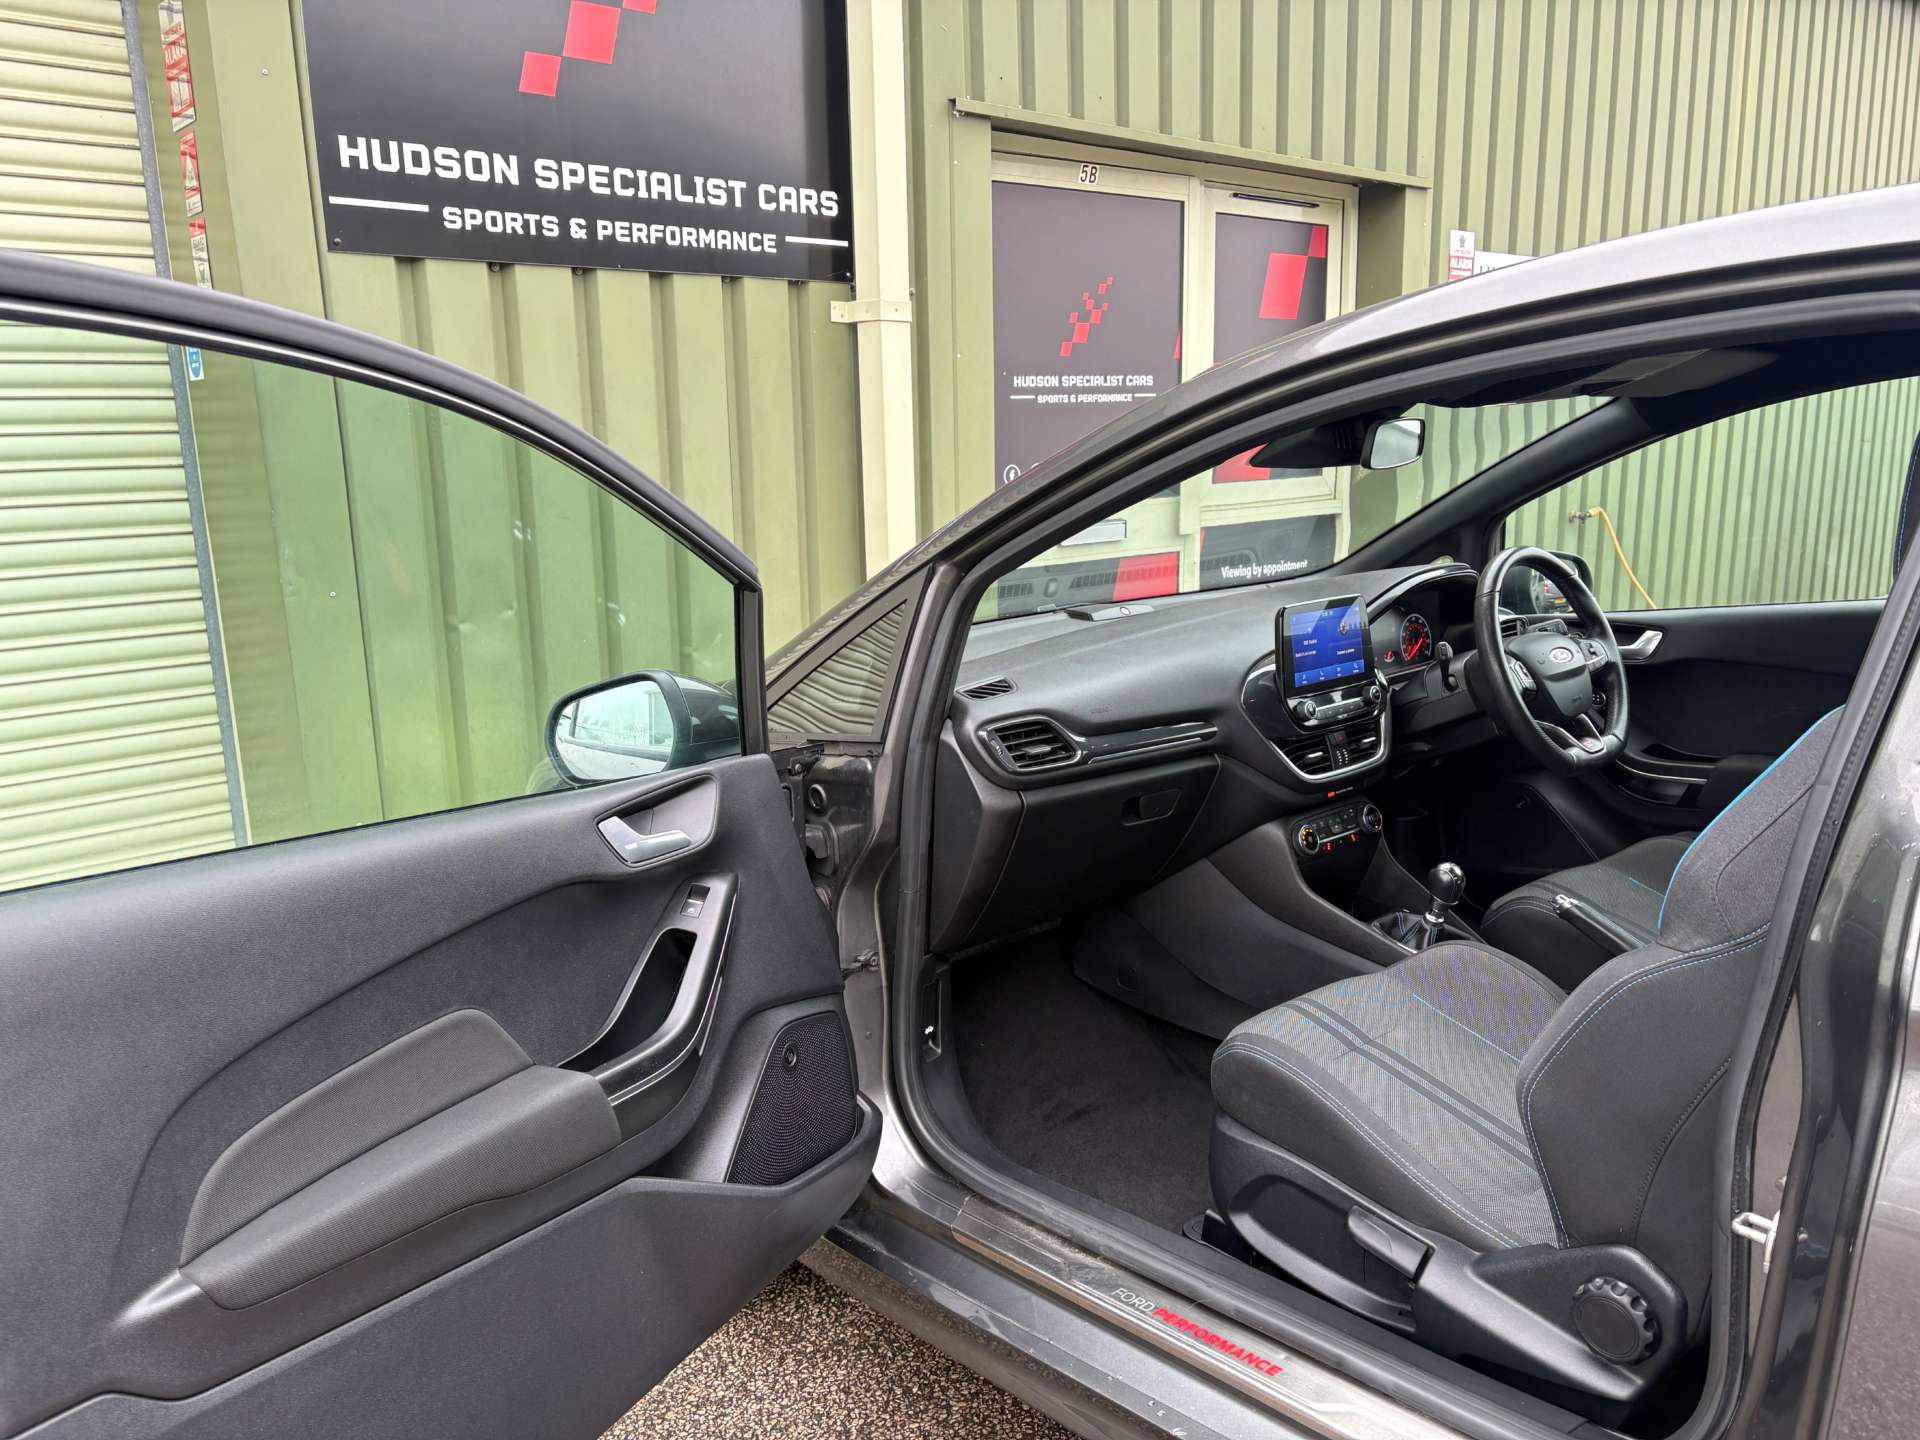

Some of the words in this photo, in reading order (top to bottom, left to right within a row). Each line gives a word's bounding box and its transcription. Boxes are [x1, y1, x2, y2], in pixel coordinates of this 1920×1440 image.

[337, 134, 520, 186] HUDSON
[534, 158, 747, 207] SPECIALIST
[757, 183, 839, 217] CARS
[1080, 164, 1098, 184] 5B
[442, 206, 560, 238] SPORTS
[569, 217, 588, 240] &
[596, 219, 778, 254] PERFORMANCE
[1013, 375, 1059, 388] HUDSON
[1061, 375, 1124, 387] SPECIALIST
[1126, 375, 1154, 386] CARS
[1037, 394, 1069, 404] SPORTS
[1077, 393, 1133, 403] PERFORMANCE
[1221, 563, 1252, 579] Viewing
[1252, 562, 1262, 577] by
[1263, 560, 1308, 576] appointment
[1110, 1287, 1156, 1313] FORD
[1152, 1305, 1285, 1377] PERFORMANCE
